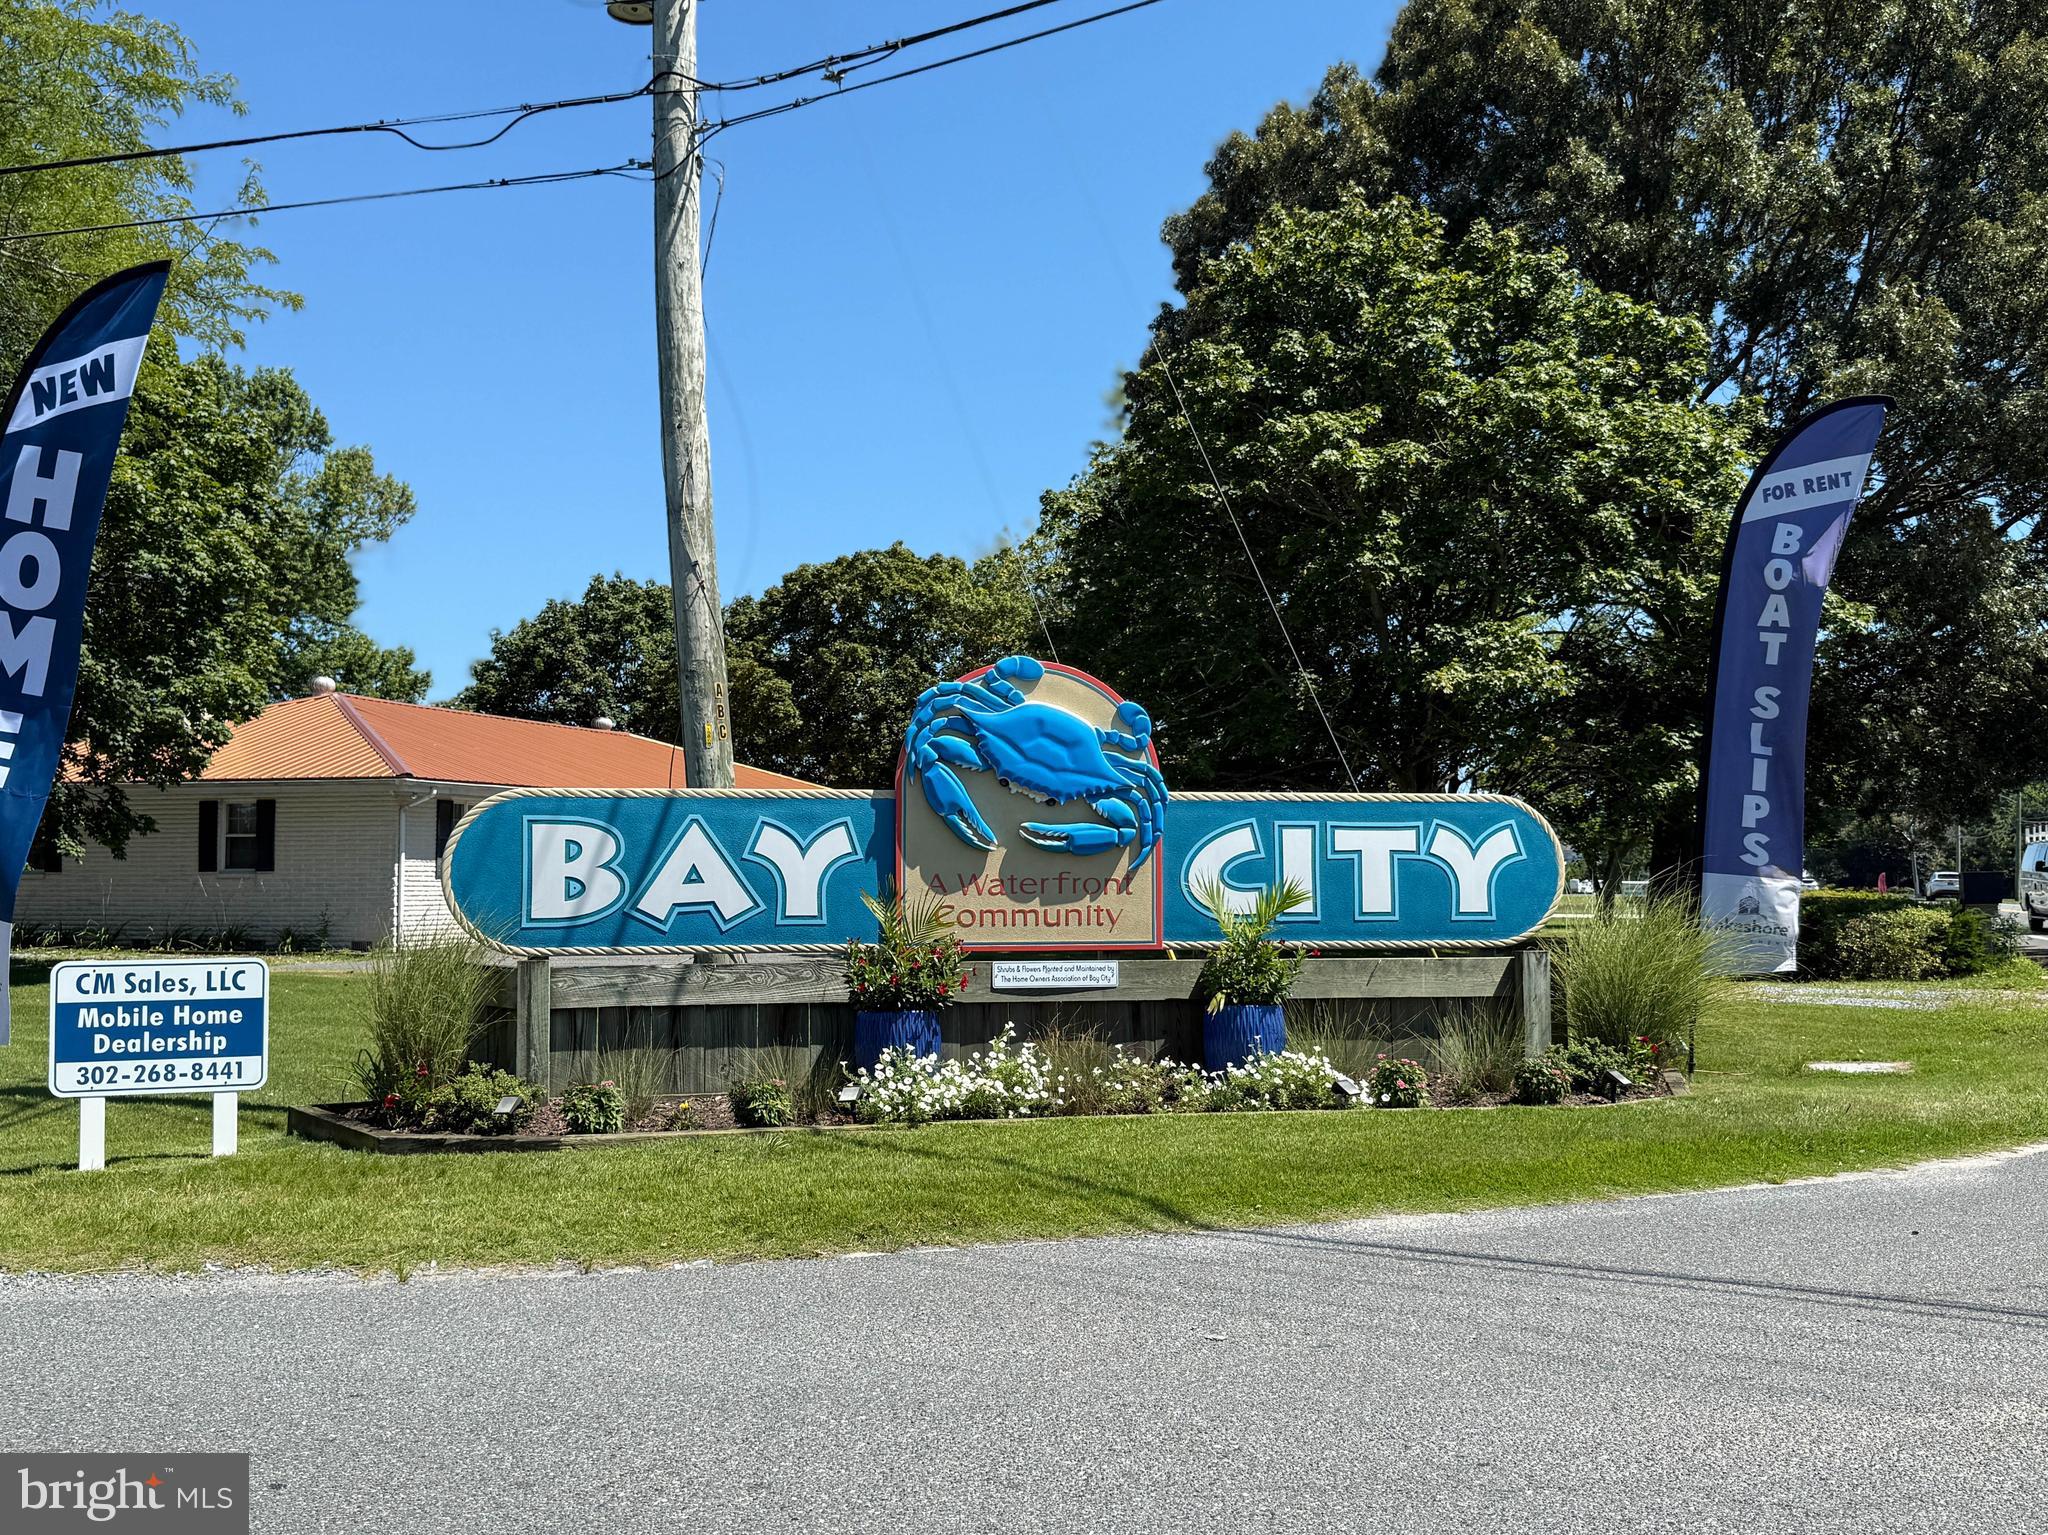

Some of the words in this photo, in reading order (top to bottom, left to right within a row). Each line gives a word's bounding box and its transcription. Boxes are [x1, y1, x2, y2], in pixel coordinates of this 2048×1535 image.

[31, 353, 116, 417] NEW
[1762, 482, 1798, 503] FOR
[1803, 471, 1853, 494] RENT
[1757, 522, 1803, 666] BOAT
[1739, 686, 1782, 867] SLIPS
[522, 814, 864, 932] BAY
[1181, 818, 1527, 921] CITY
[927, 873, 947, 894] A
[958, 871, 1133, 896] Waterfront
[934, 904, 1124, 934] Community
[996, 965, 1015, 973] Shrubs
[1076, 964, 1106, 972] Maintained
[1089, 975, 1100, 983] Bay
[76, 973, 115, 994] CM
[125, 970, 197, 996] Sales,
[206, 969, 246, 991] LLC
[78, 1005, 164, 1028] Mobile
[174, 1005, 243, 1026] Home
[94, 1030, 227, 1055] Dealership
[76, 1061, 243, 1086] 302-268-8441
